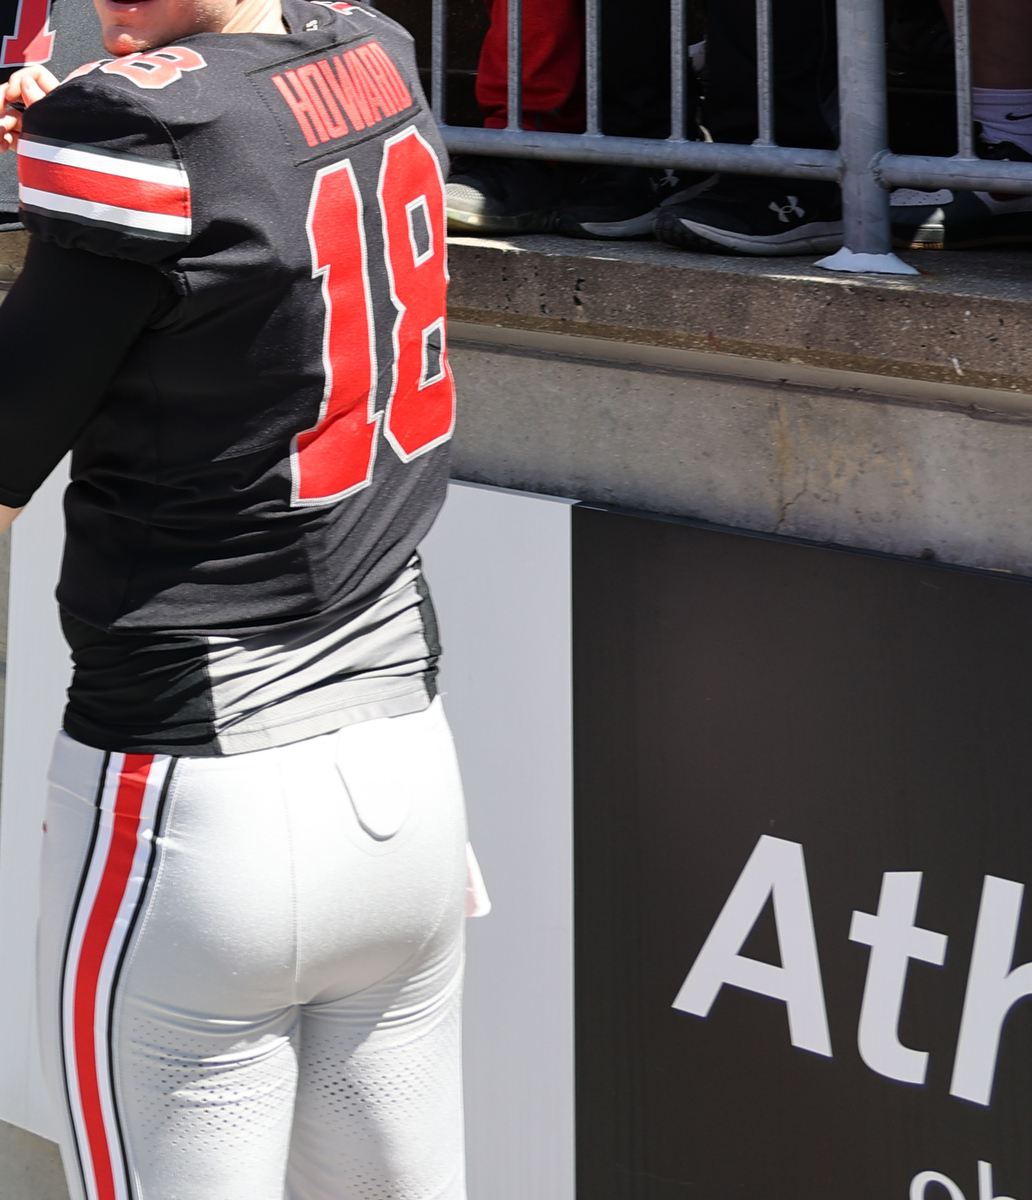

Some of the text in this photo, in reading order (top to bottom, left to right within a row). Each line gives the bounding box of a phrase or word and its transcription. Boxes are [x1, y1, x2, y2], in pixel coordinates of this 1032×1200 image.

[270, 40, 414, 148] HOWARD
[290, 125, 456, 507] 18
[671, 833, 1032, 1107] Ath
